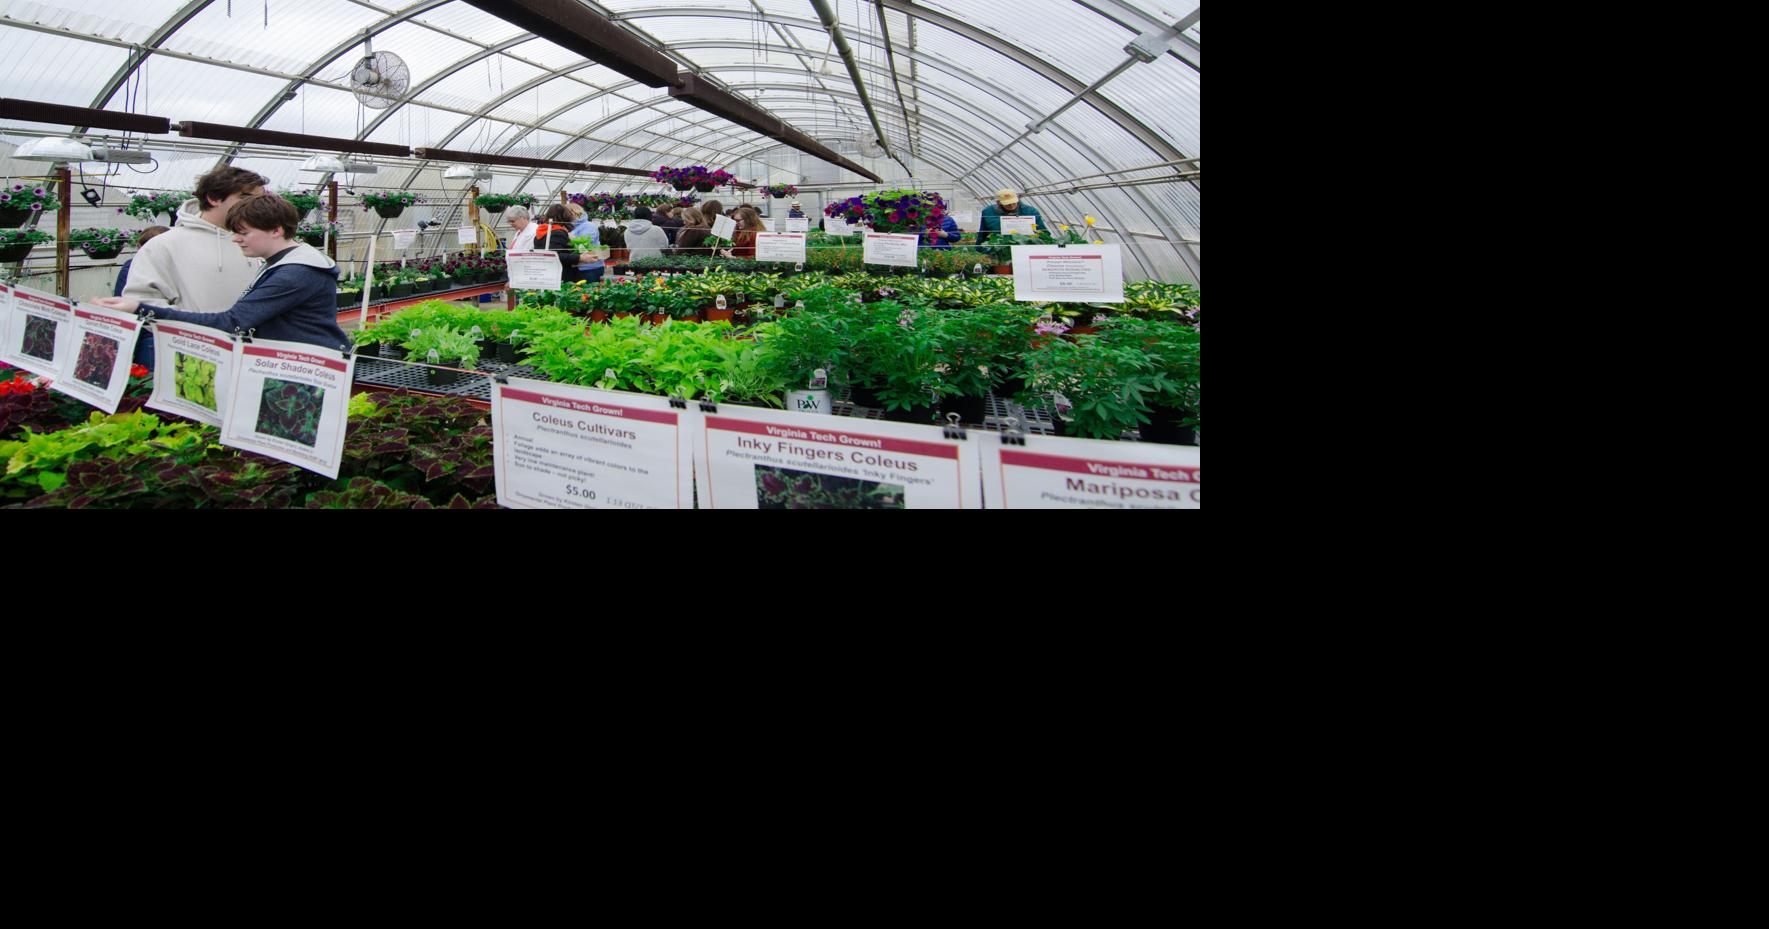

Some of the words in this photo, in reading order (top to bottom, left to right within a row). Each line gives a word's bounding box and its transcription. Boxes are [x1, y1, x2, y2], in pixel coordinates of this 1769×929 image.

[255, 358, 278, 369] Solar
[280, 362, 314, 375] Shadow
[314, 368, 336, 381] Coleus
[541, 396, 571, 408] Virginia
[571, 401, 591, 411] Tech
[592, 404, 623, 417] Grown!
[533, 411, 574, 428] Coleus
[577, 420, 636, 440] Cultivars
[766, 425, 808, 440] Virginia
[809, 431, 836, 443] Tech
[838, 434, 882, 449] Grown!
[560, 451, 575, 460] array
[637, 467, 649, 475] the
[726, 448, 783, 464] Plectranthus
[786, 459, 858, 475] scutellarioides
[737, 436, 771, 454] Inky
[778, 441, 845, 462] Fingers
[850, 451, 918, 472] Coleus
[1086, 461, 1148, 479] Virginia
[1149, 466, 1190, 482] Tech
[566, 484, 596, 500] $5.00
[1065, 476, 1180, 501] Mariposa
